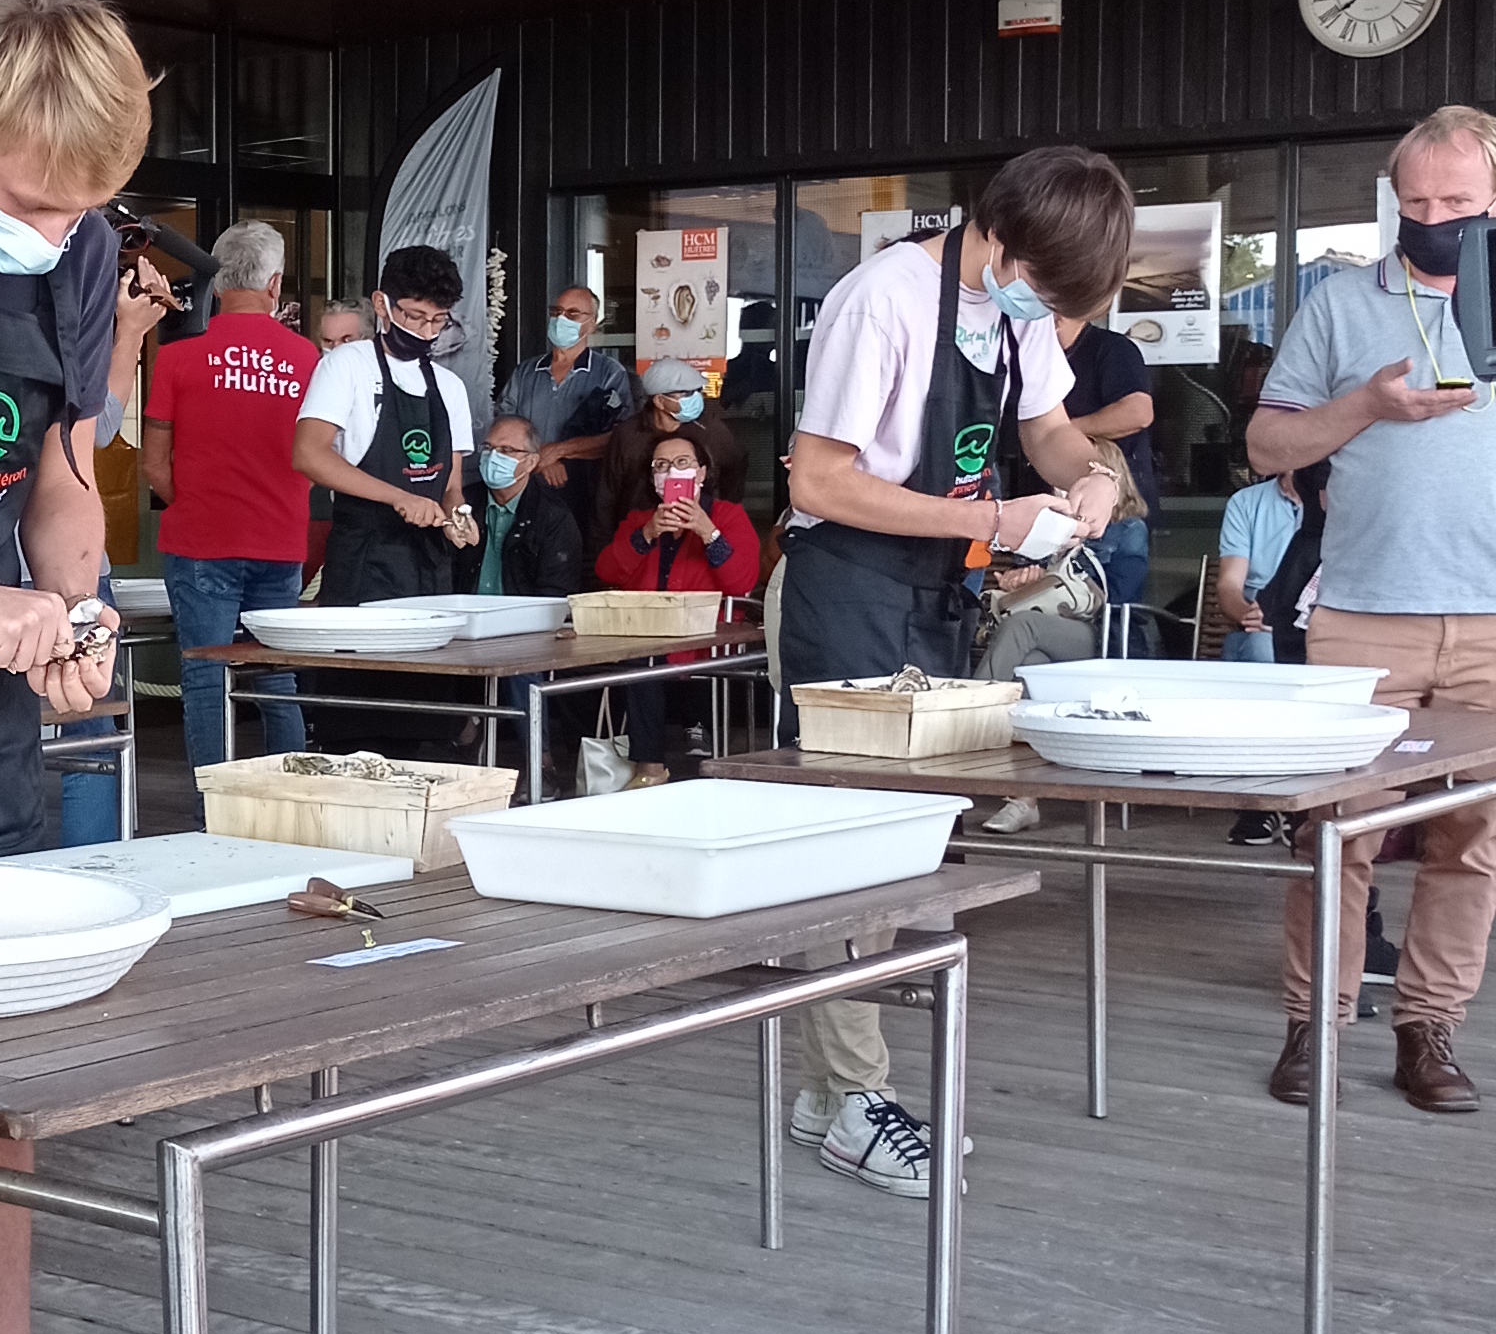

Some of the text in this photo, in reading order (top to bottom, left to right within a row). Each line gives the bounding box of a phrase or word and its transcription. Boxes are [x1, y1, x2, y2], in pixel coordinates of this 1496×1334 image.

[913, 214, 949, 229] HCM
[684, 233, 716, 247] HCM
[208, 345, 294, 375] la Cité de
[214, 368, 301, 398] l'Huître
